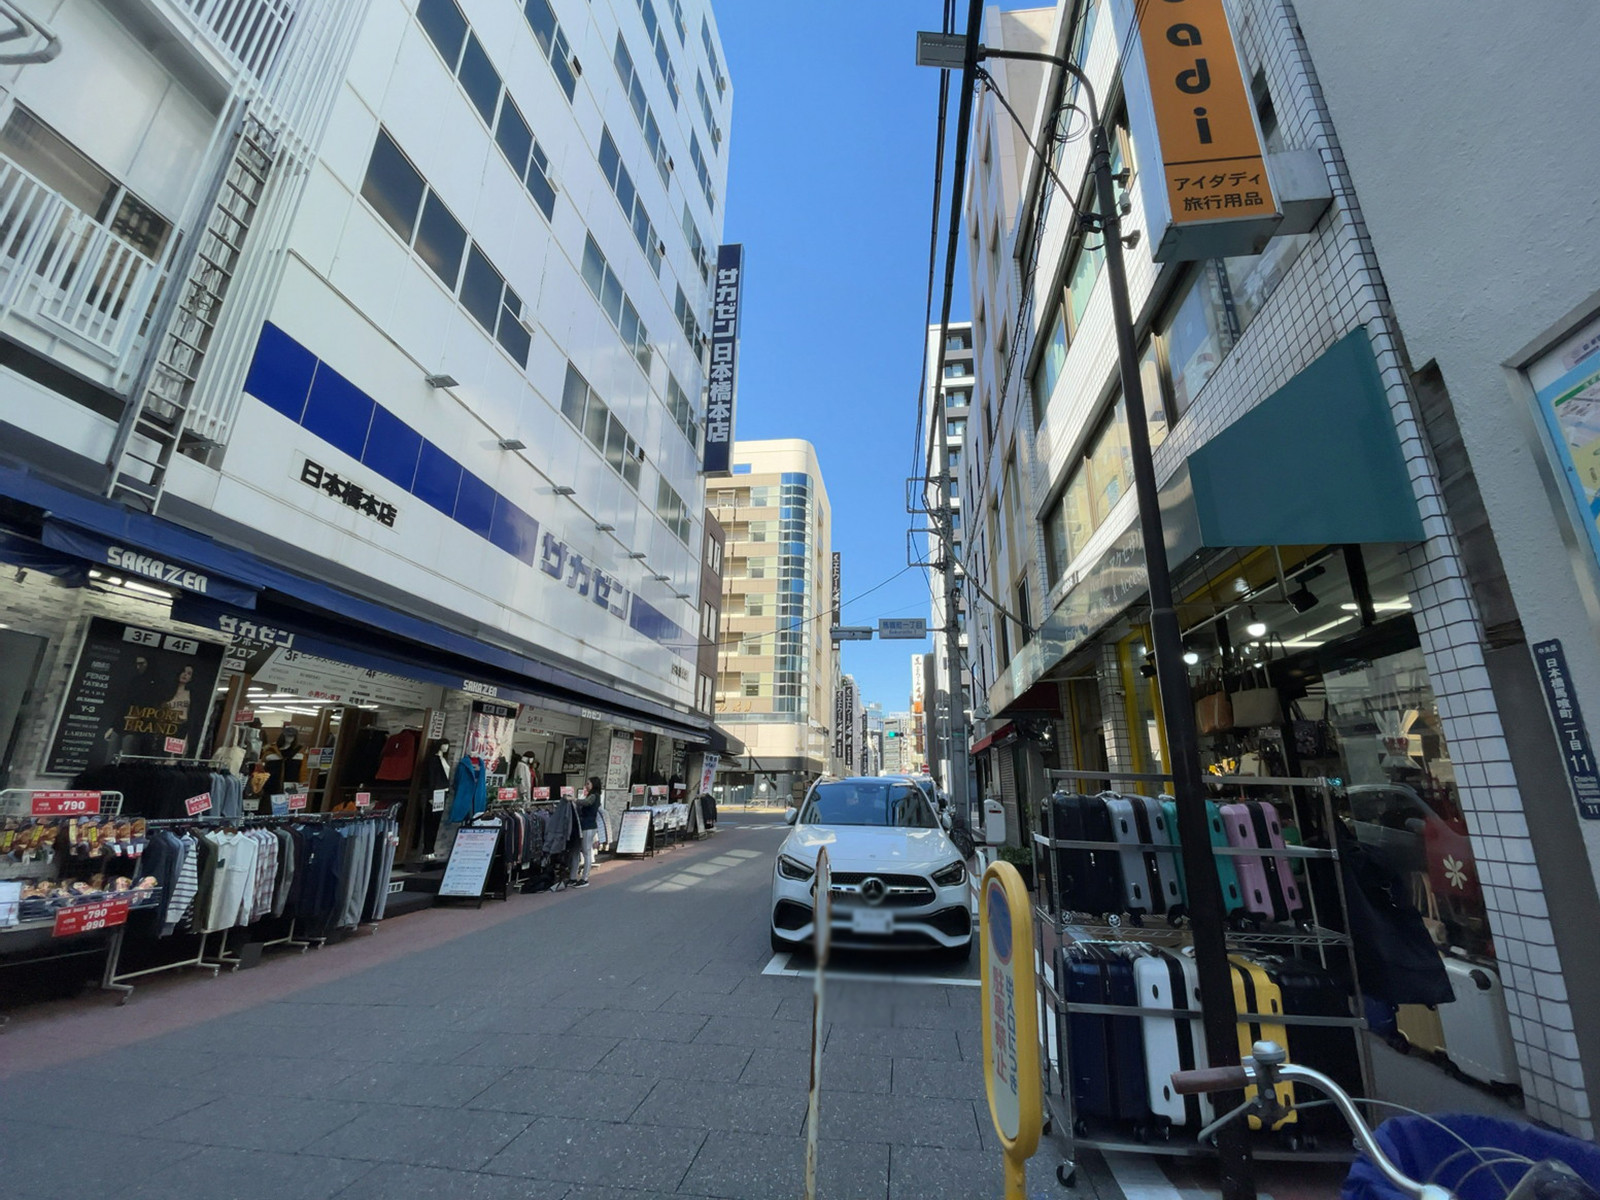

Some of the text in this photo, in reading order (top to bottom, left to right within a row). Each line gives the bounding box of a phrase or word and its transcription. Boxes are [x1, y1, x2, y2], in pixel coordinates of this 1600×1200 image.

[1163, 0, 1213, 144] adi
[1174, 171, 1262, 191] アイダディ
[1183, 191, 1264, 212] 旅行用品
[300, 457, 399, 528] 日本橋本店
[540, 532, 631, 620] サカゼン
[131, 631, 191, 651] 3F 4F
[218, 614, 295, 649] サカゼン
[283, 649, 299, 662] 3F
[280, 686, 299, 695] retail
[80, 705, 96, 713] Y-3
[128, 704, 183, 721] IMPORT
[123, 718, 178, 736] BRAND
[1570, 754, 1591, 772] 11
[992, 966, 1008, 1084] 駐車禁止
